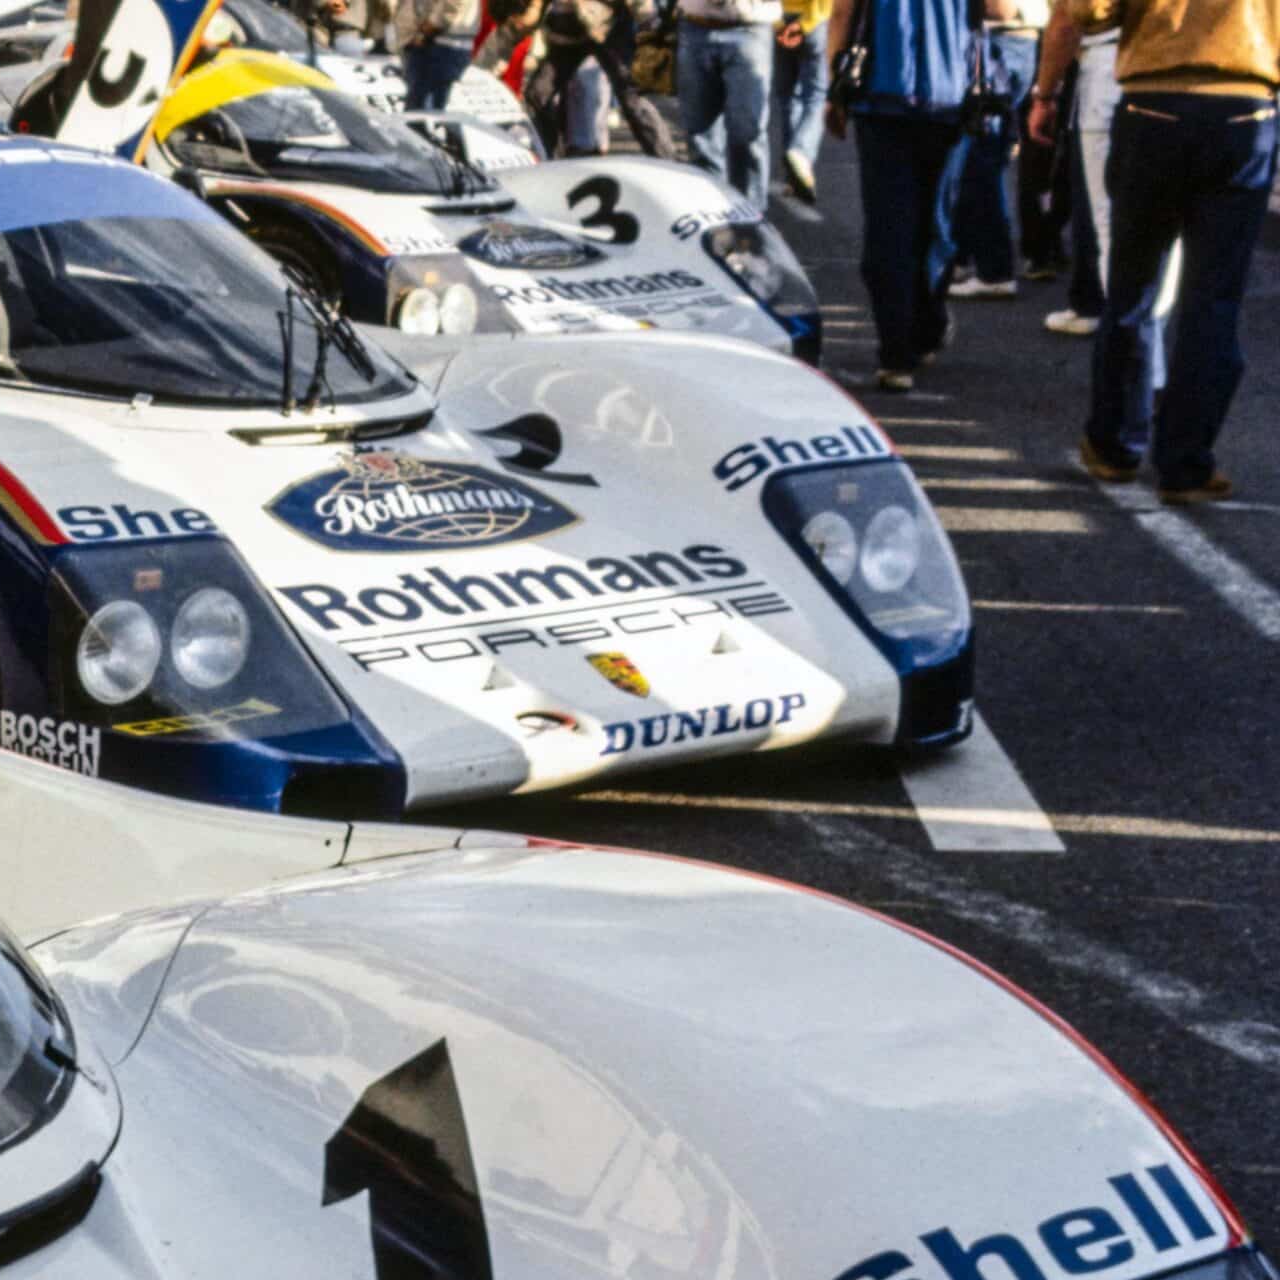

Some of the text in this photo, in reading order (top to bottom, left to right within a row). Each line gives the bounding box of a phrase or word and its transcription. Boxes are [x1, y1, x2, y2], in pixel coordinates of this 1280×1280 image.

[566, 174, 640, 245] 3
[489, 270, 704, 304] Rothmans
[713, 426, 885, 492] Shell
[314, 485, 552, 535] Rothmans
[276, 544, 748, 630] Rothmans
[349, 592, 793, 672] PORSCHE
[0, 710, 101, 757] BOSCH
[601, 693, 805, 755] DUNLOP
